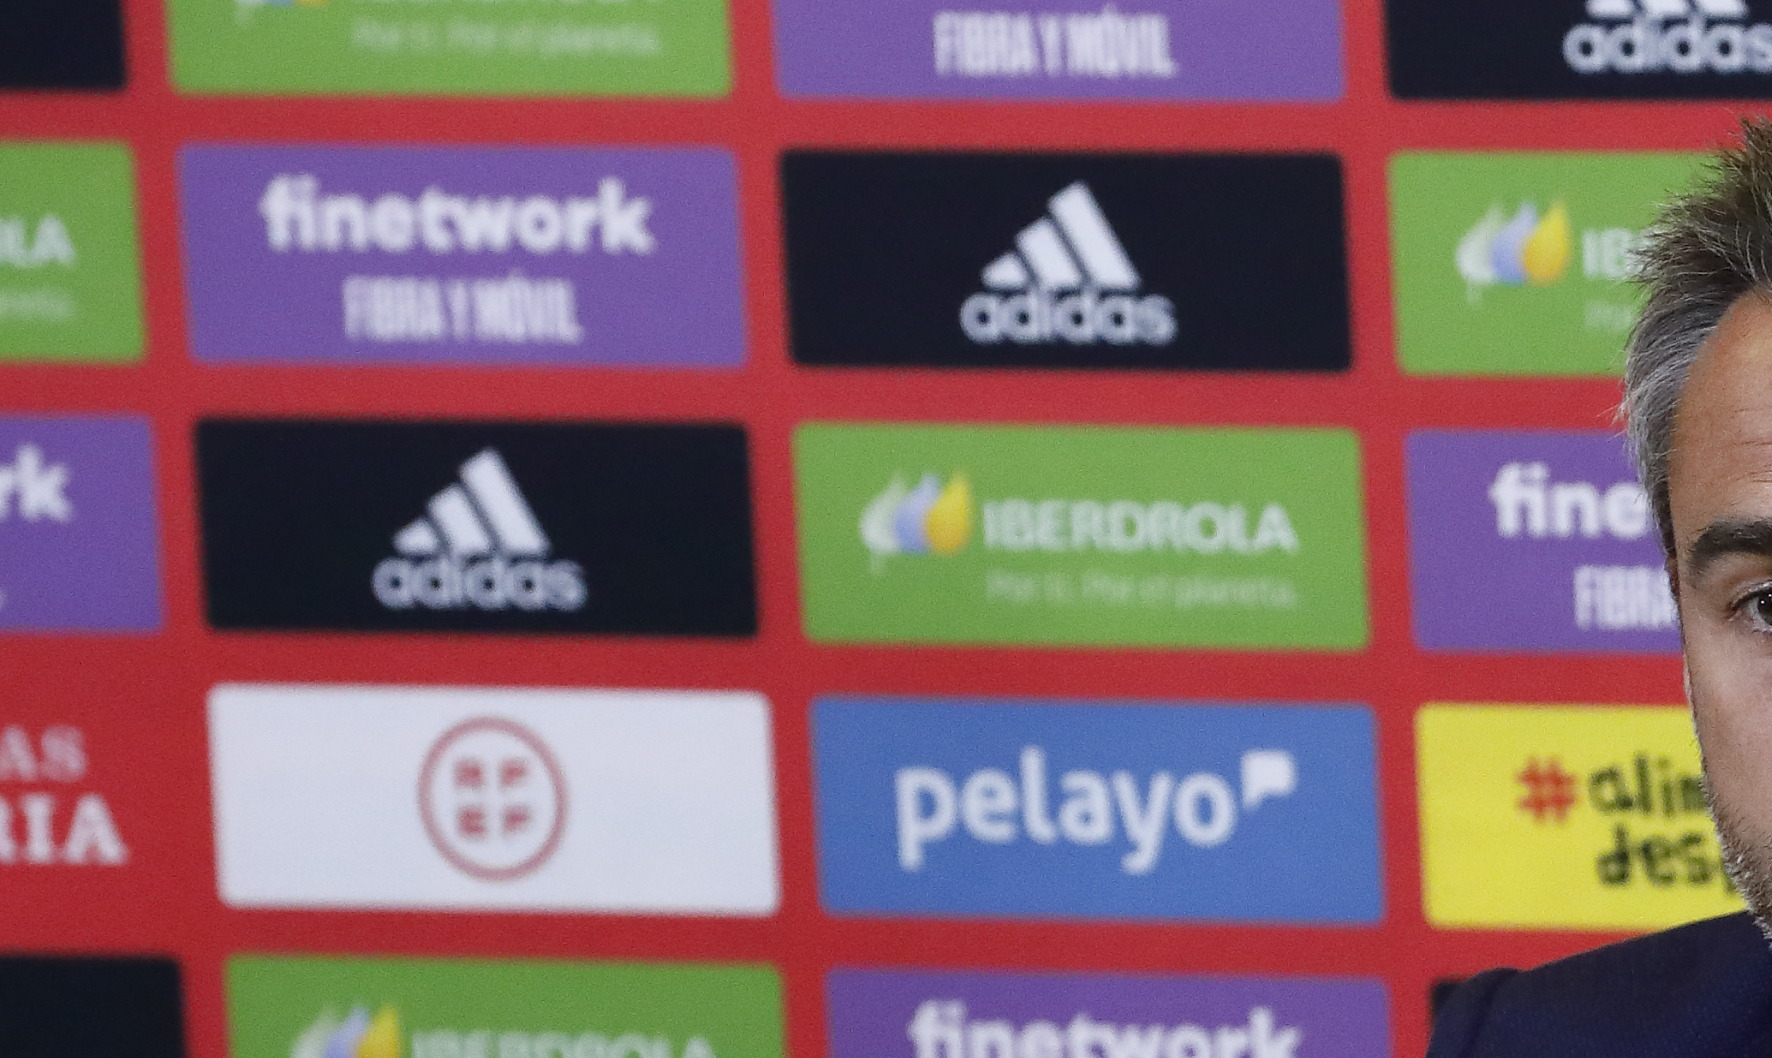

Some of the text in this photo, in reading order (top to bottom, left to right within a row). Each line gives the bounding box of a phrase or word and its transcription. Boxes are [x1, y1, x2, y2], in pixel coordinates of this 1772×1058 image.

[933, 4, 1178, 78] FIBRA Y MÓVIL
[260, 175, 654, 254] finetwork
[343, 270, 582, 343] FIBRA Y MÓVIL
[960, 288, 1177, 344] adidas
[983, 498, 1300, 556] IBERDROLA
[372, 556, 587, 610] adidas
[894, 745, 1238, 875] pelayo
